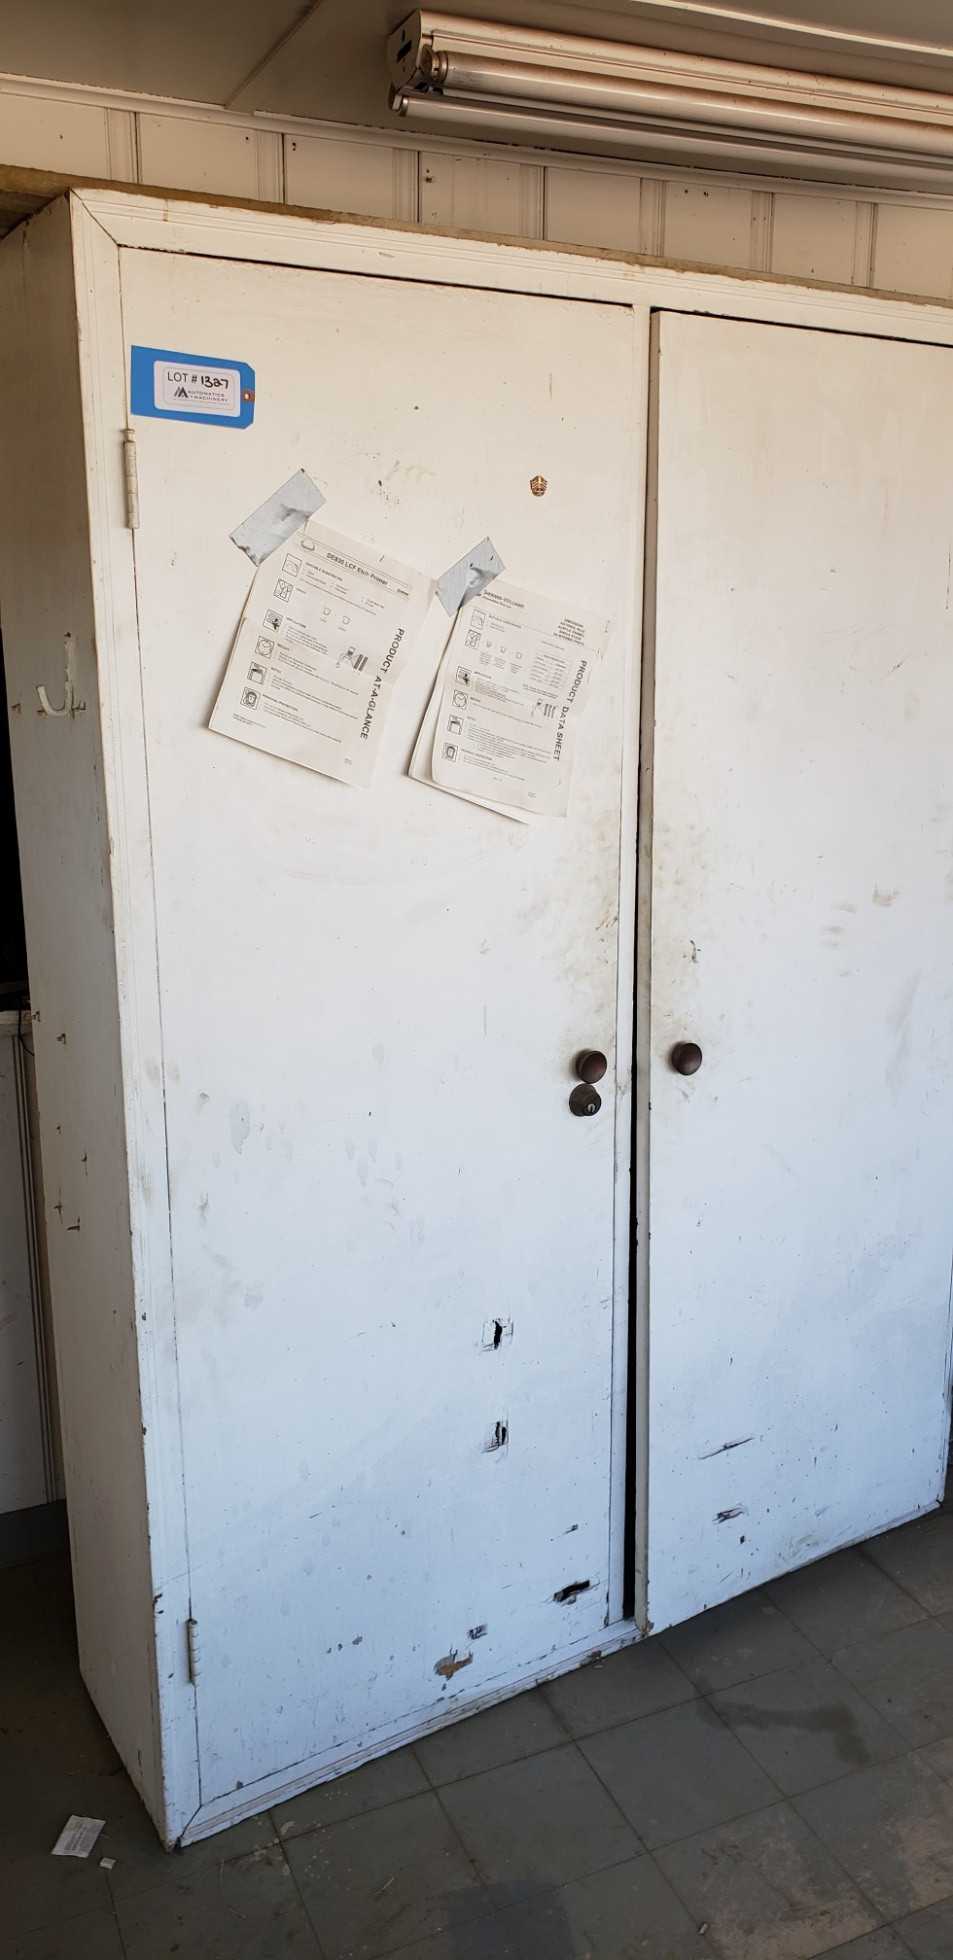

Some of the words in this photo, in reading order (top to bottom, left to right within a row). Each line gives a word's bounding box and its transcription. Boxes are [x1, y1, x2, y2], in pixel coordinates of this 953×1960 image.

[167, 371, 188, 383] LOT
[191, 374, 198, 384] #
[201, 375, 229, 389] 1327
[380, 627, 405, 674] PRODUCT
[566, 660, 588, 703] PRODUCT
[558, 706, 570, 730] DATA
[552, 731, 564, 761] SHEET
